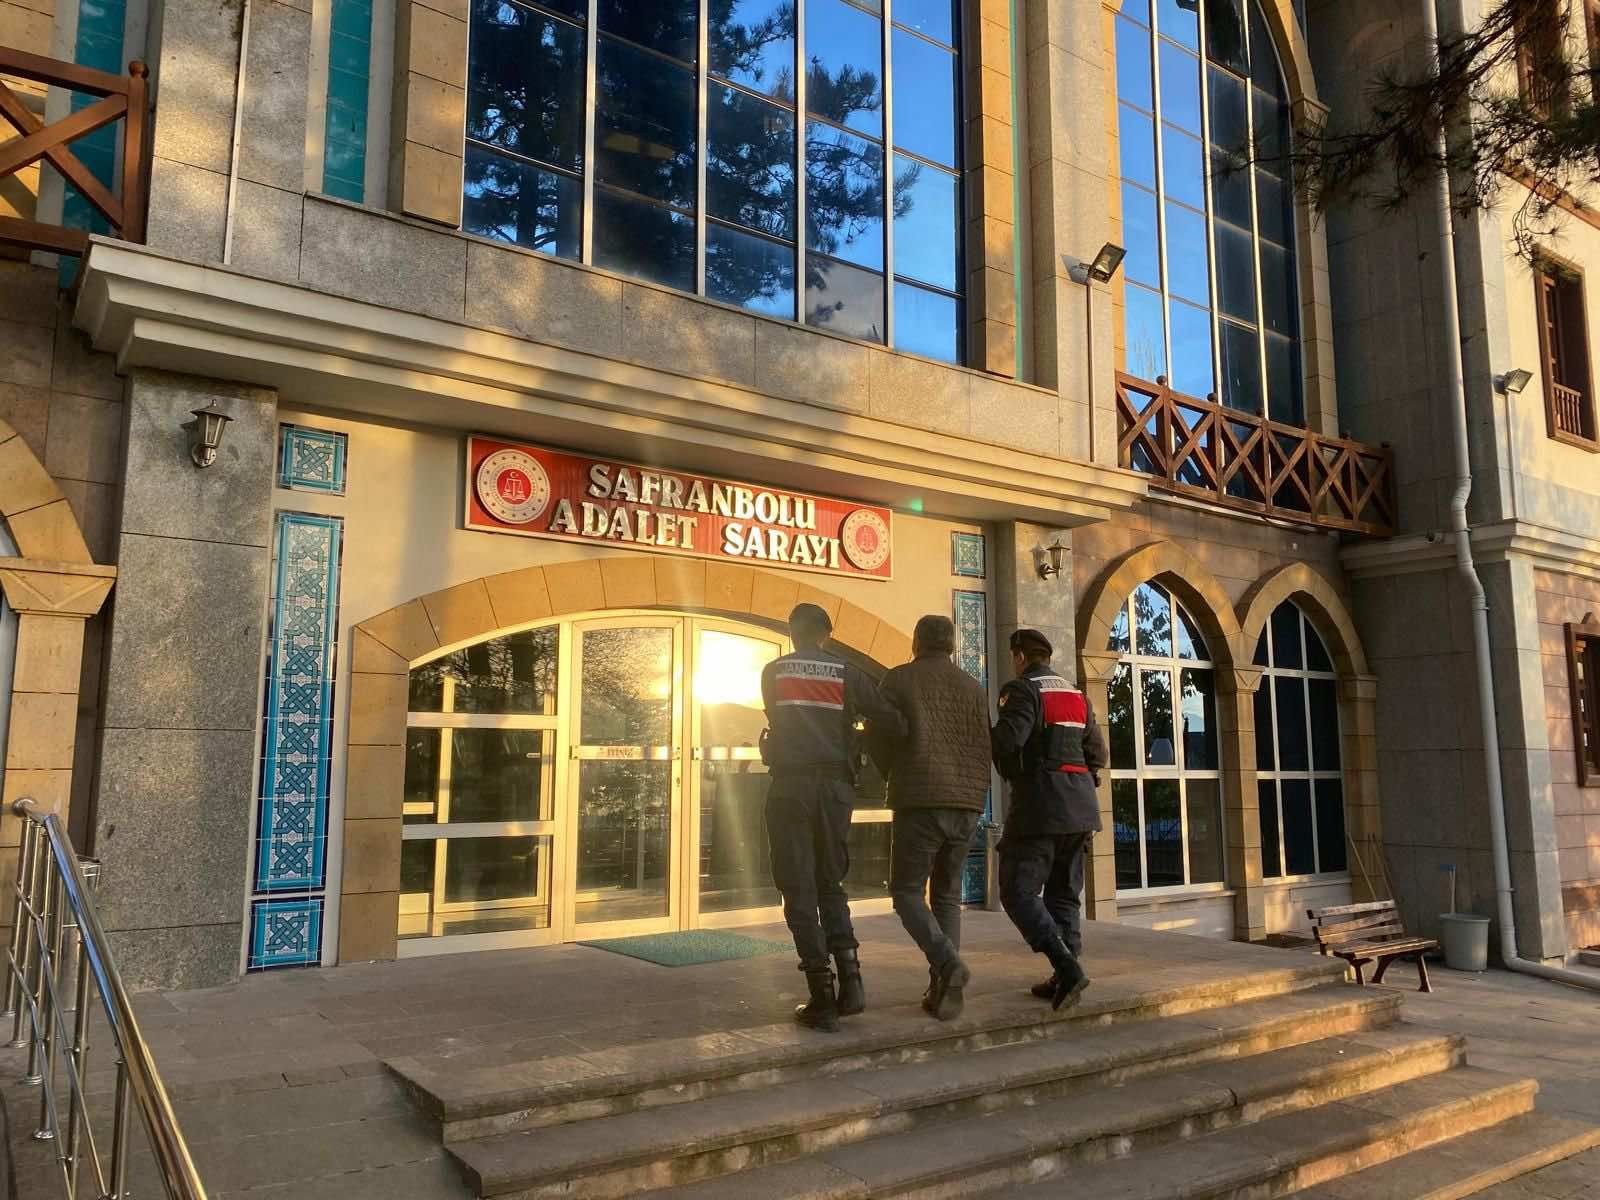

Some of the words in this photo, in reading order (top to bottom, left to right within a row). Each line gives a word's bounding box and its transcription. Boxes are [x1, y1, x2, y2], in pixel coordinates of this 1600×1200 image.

[589, 463, 816, 530] SAFRANBOLU
[549, 499, 697, 549] ADALET
[724, 523, 840, 568] SARAYI
